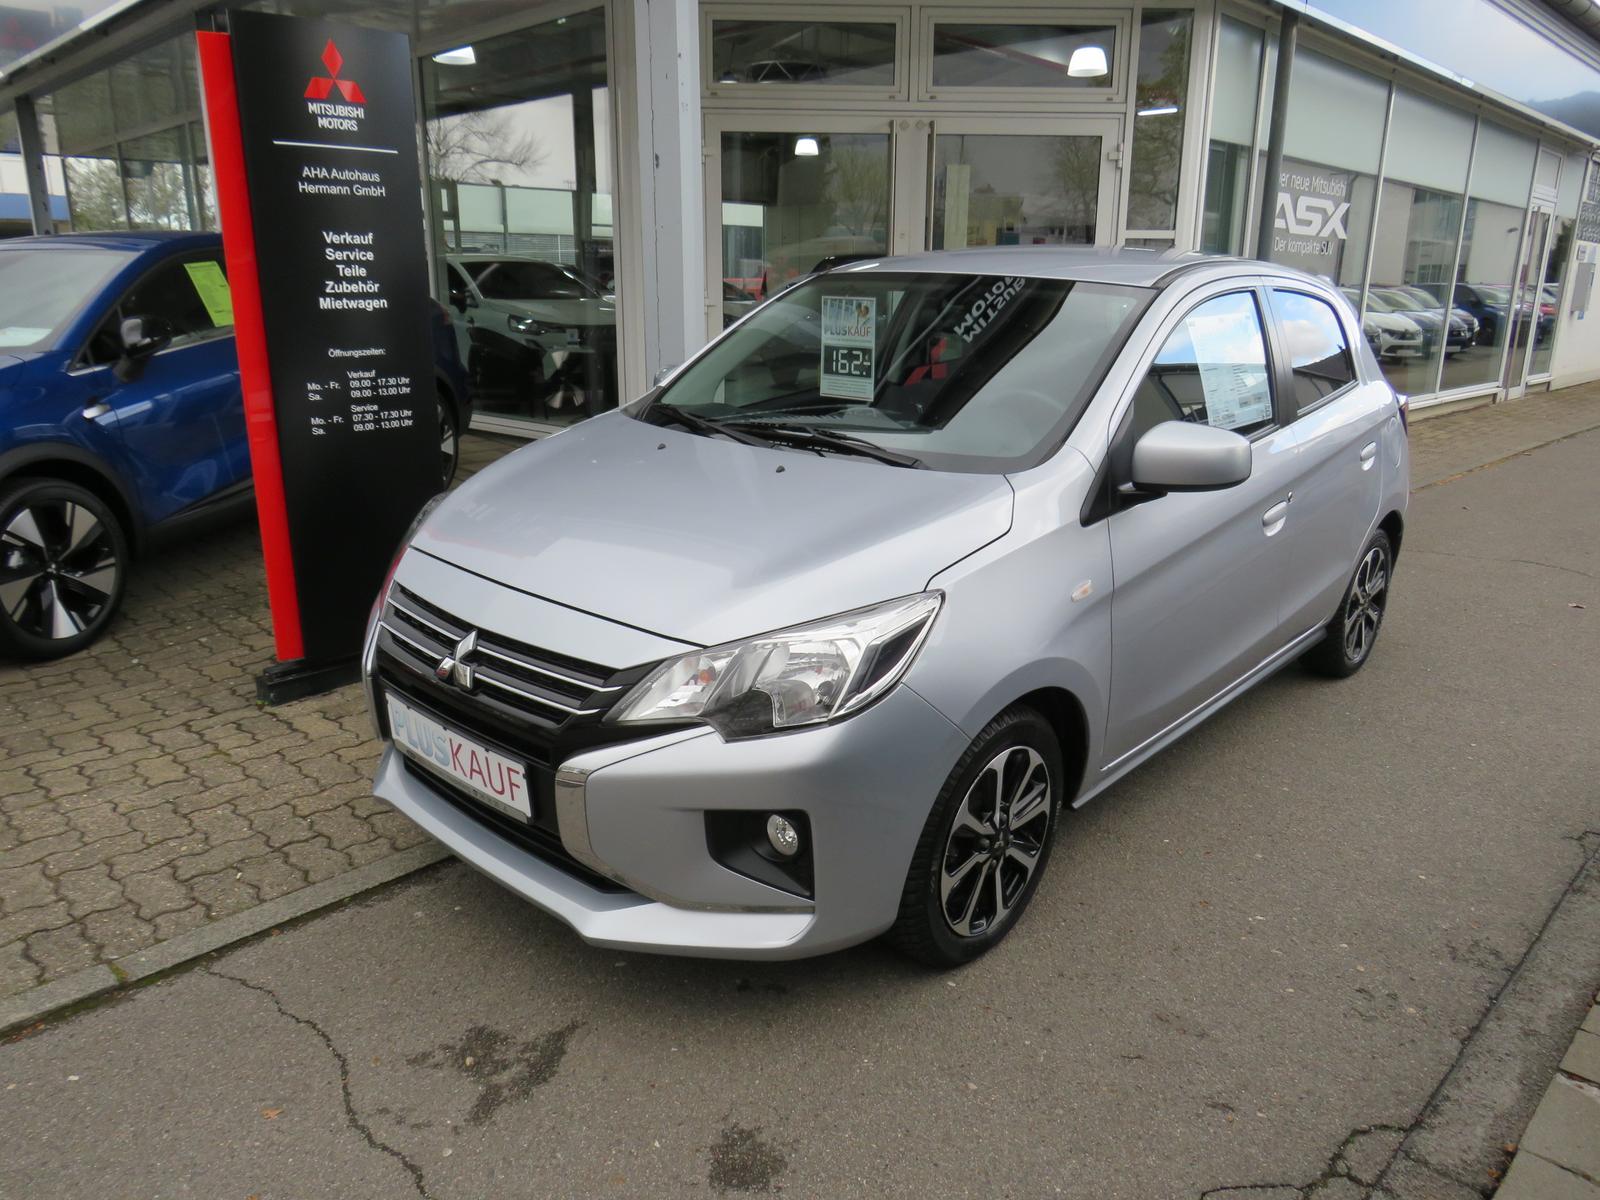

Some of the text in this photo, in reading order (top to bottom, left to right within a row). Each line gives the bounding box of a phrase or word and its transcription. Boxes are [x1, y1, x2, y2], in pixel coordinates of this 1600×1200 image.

[307, 102, 365, 120] MITSUBISHI
[317, 116, 359, 132] MOTORS
[302, 166, 380, 183] AHA Autohaus
[298, 182, 386, 197] Hermann GmbH
[1290, 174, 1310, 190] neue
[1310, 175, 1347, 197] Mitsubishi
[1274, 192, 1351, 240] ASX
[322, 231, 374, 245] Verkauf
[324, 247, 375, 262] Service
[1274, 237, 1334, 257] Der kompakte SUV
[336, 264, 367, 278] Teile
[324, 280, 380, 294] Zubehör
[319, 296, 388, 312] Mietwagen
[823, 325, 873, 337] PLUSKAUF
[328, 347, 386, 359] Öffnungszeiten:
[346, 369, 376, 379] Verkauf
[307, 382, 323, 391] Mo.
[330, 381, 341, 390] Fr.
[350, 379, 371, 389] 09.00
[377, 378, 397, 387] 17.30
[398, 377, 410, 386] Uhr
[308, 392, 323, 401] Sa.
[350, 389, 371, 398] 09.00
[378, 387, 398, 397] 13.00
[399, 386, 411, 395] Uhr
[350, 403, 378, 413] Service
[311, 416, 327, 426] Mo.
[333, 415, 344, 424] Fr.
[352, 413, 373, 422] 07.30
[380, 411, 400, 420] 17.30
[400, 409, 412, 418] Uhr
[312, 426, 326, 436] Sa.
[353, 423, 374, 432] 09.00
[381, 420, 401, 430] 13.00
[401, 419, 414, 428] Uhr
[391, 701, 521, 801] PLUSKAUF
